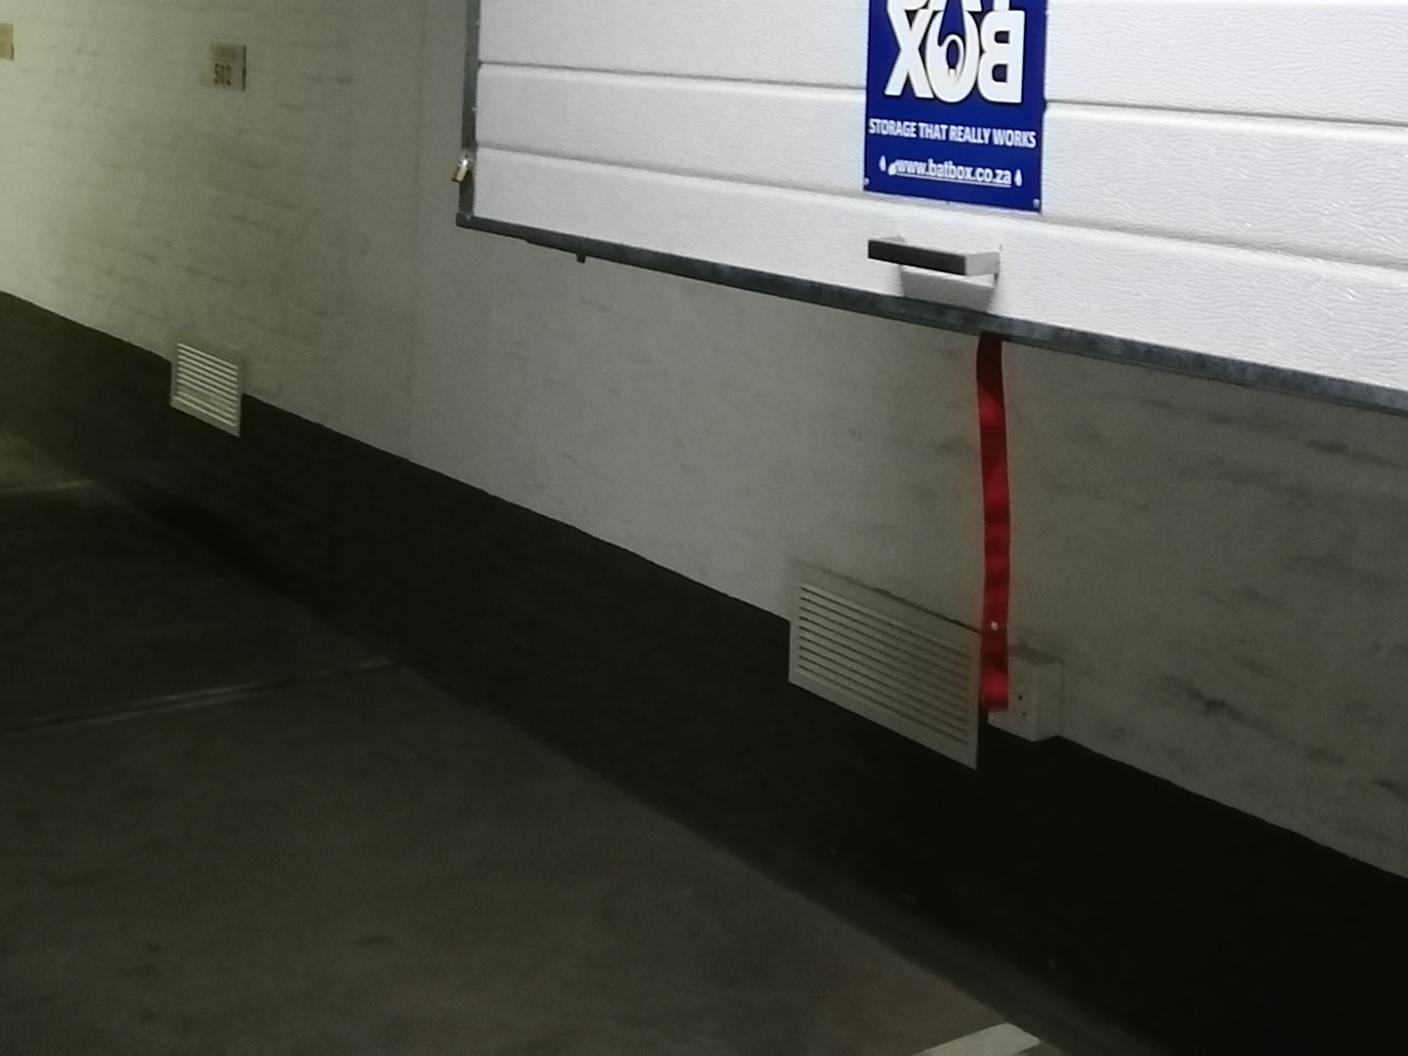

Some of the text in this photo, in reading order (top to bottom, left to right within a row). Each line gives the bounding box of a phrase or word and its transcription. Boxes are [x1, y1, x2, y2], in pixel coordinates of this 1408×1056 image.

[868, 118, 1037, 148] STORAGE THAT REALLY WORKS
[894, 157, 1012, 185] www.batbox.co.za
